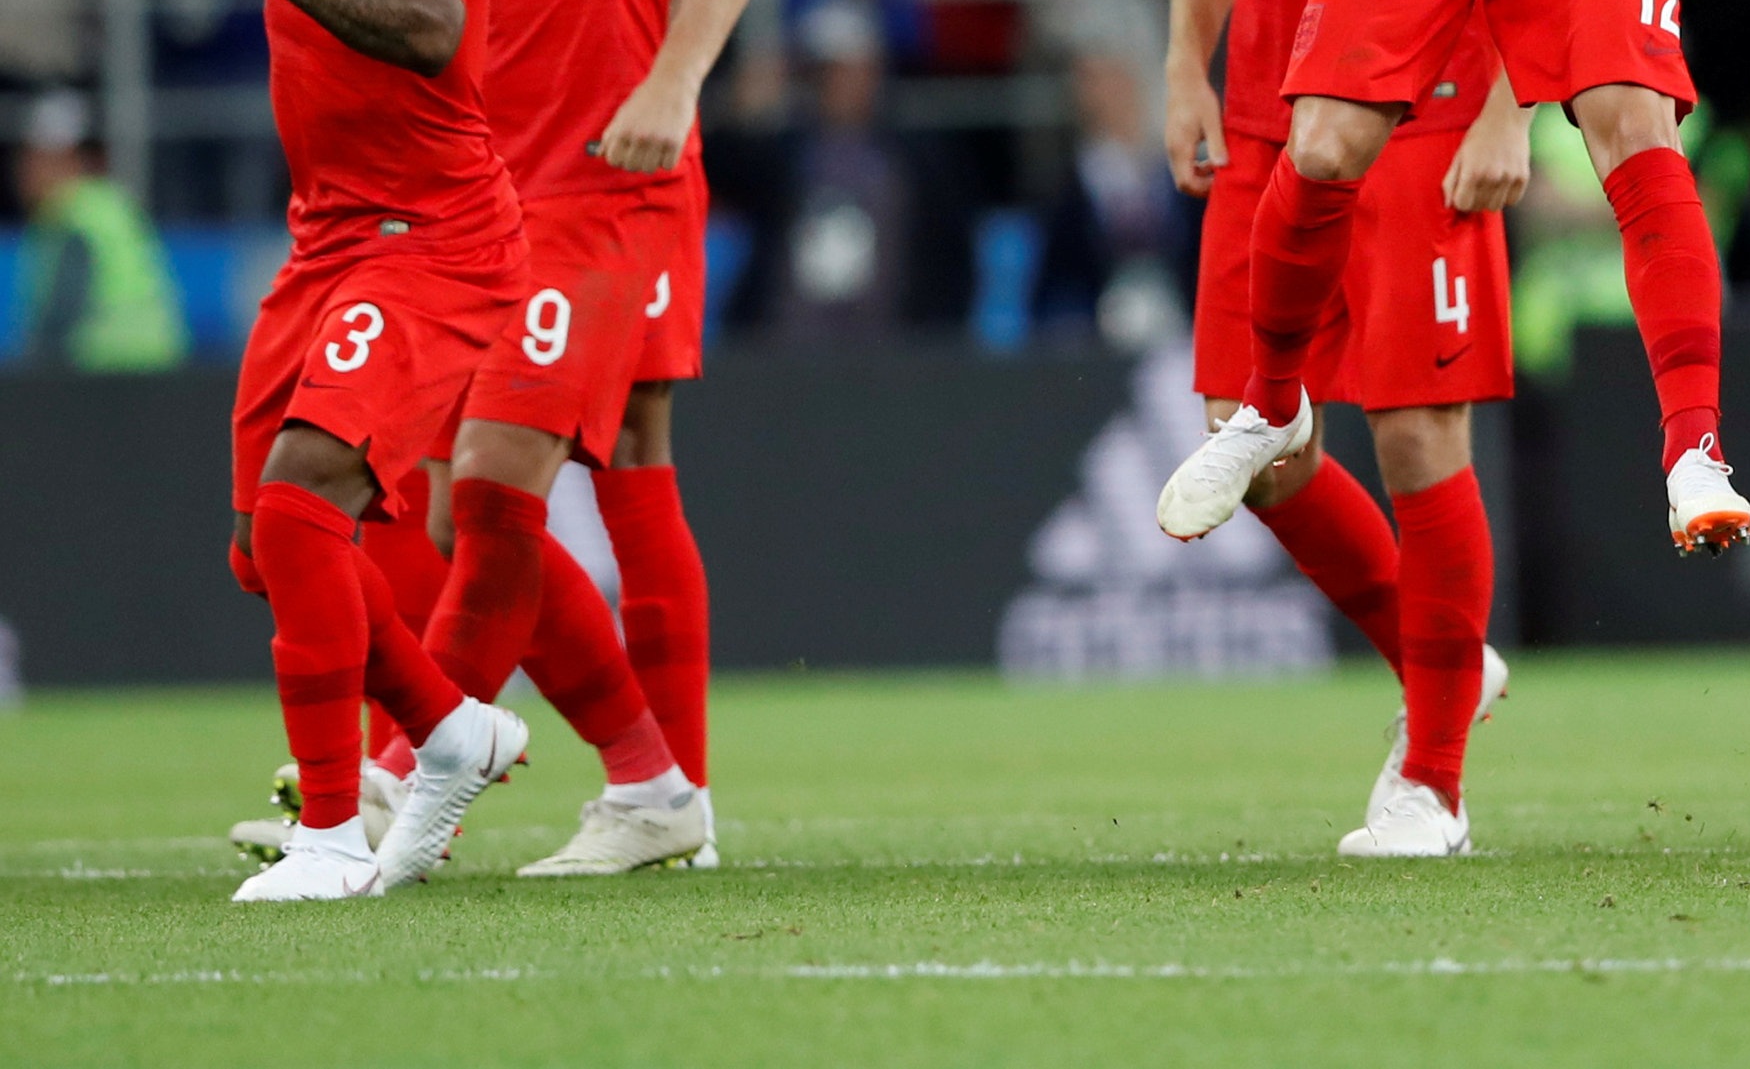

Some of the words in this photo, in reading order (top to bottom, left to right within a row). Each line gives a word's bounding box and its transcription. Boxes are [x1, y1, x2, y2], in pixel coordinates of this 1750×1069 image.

[521, 288, 572, 366] 9
[1432, 256, 1470, 334] 4
[324, 302, 385, 373] 3
